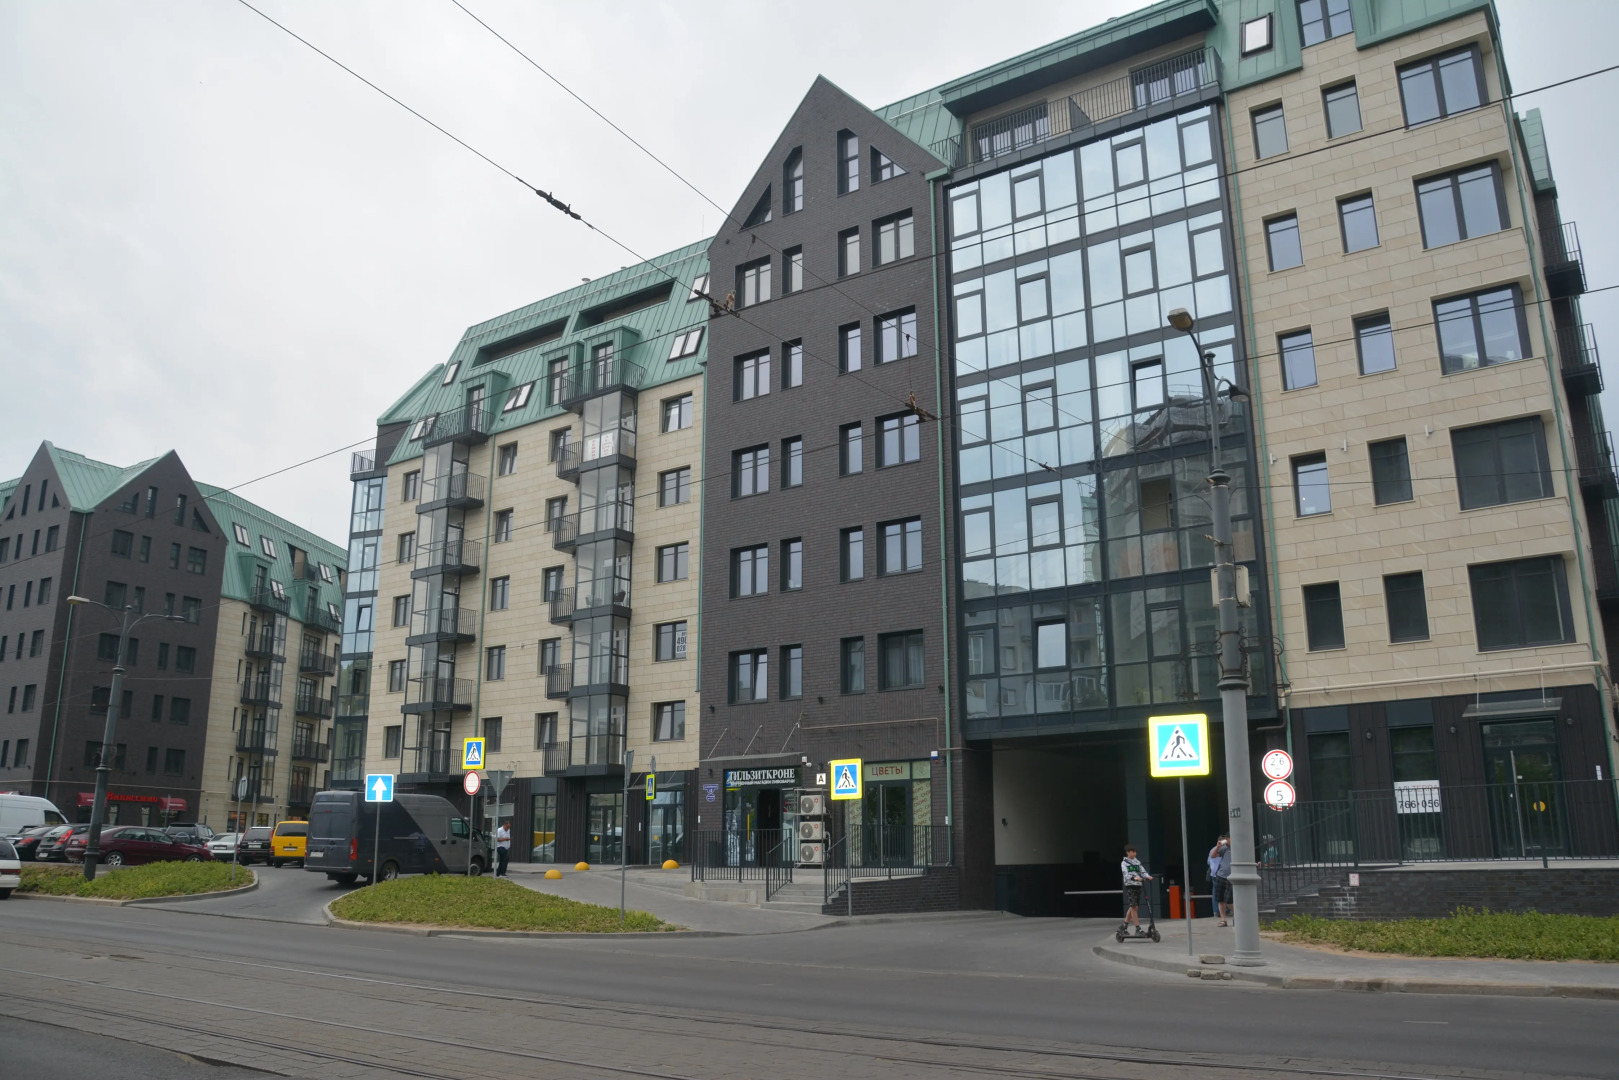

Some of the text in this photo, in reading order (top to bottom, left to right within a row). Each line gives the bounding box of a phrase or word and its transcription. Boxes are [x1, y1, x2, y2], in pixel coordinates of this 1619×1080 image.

[729, 769, 795, 780] ТИЛЬЗИТКРОНЕ
[872, 766, 903, 776] ЦВЕТЫ
[1276, 790, 1284, 802] 5
